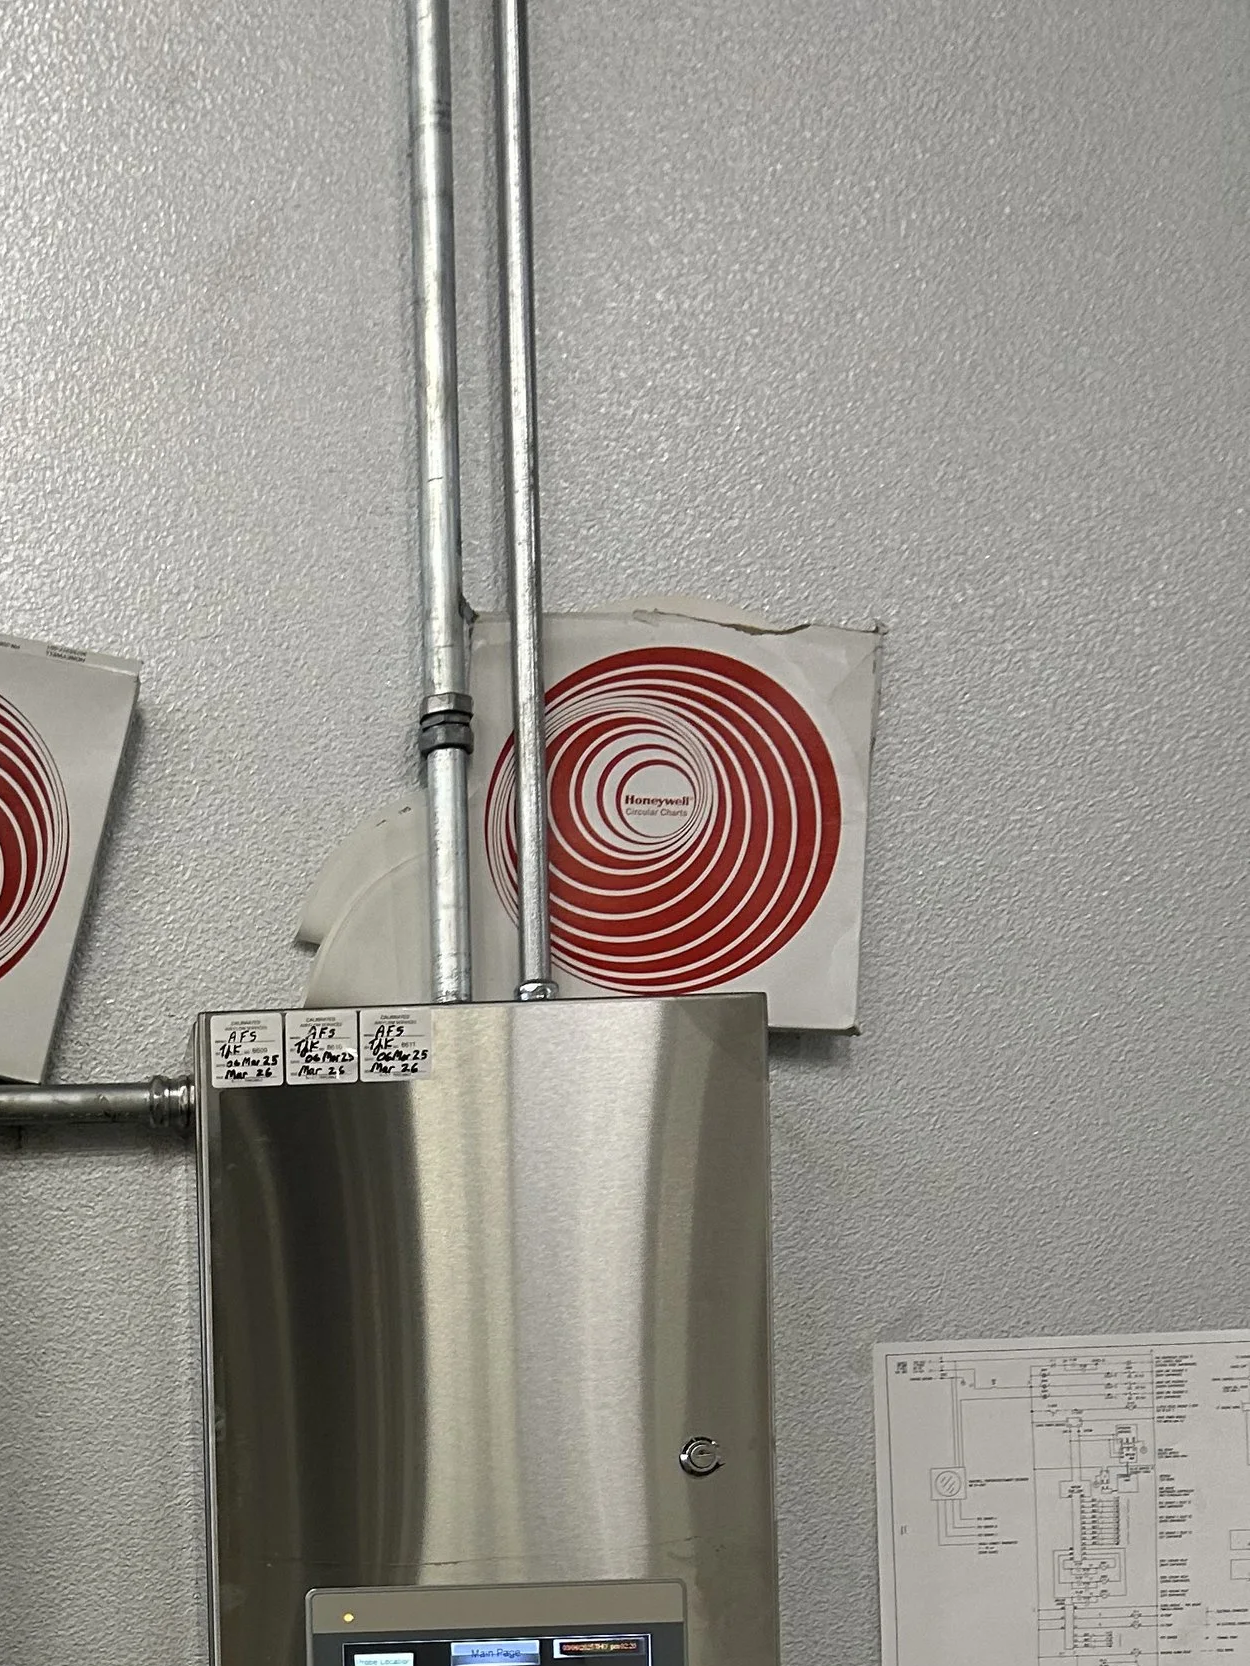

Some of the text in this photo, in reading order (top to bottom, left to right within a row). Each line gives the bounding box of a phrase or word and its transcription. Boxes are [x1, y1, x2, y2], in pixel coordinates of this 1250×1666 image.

[625, 807, 688, 817] Circular Charts
[262, 1054, 280, 1066] 25
[412, 1049, 429, 1060] 25
[298, 1065, 323, 1077] Mar
[370, 1062, 418, 1073] Mar 26
[224, 1067, 273, 1080] Mar 26
[496, 1649, 521, 1659] Page
